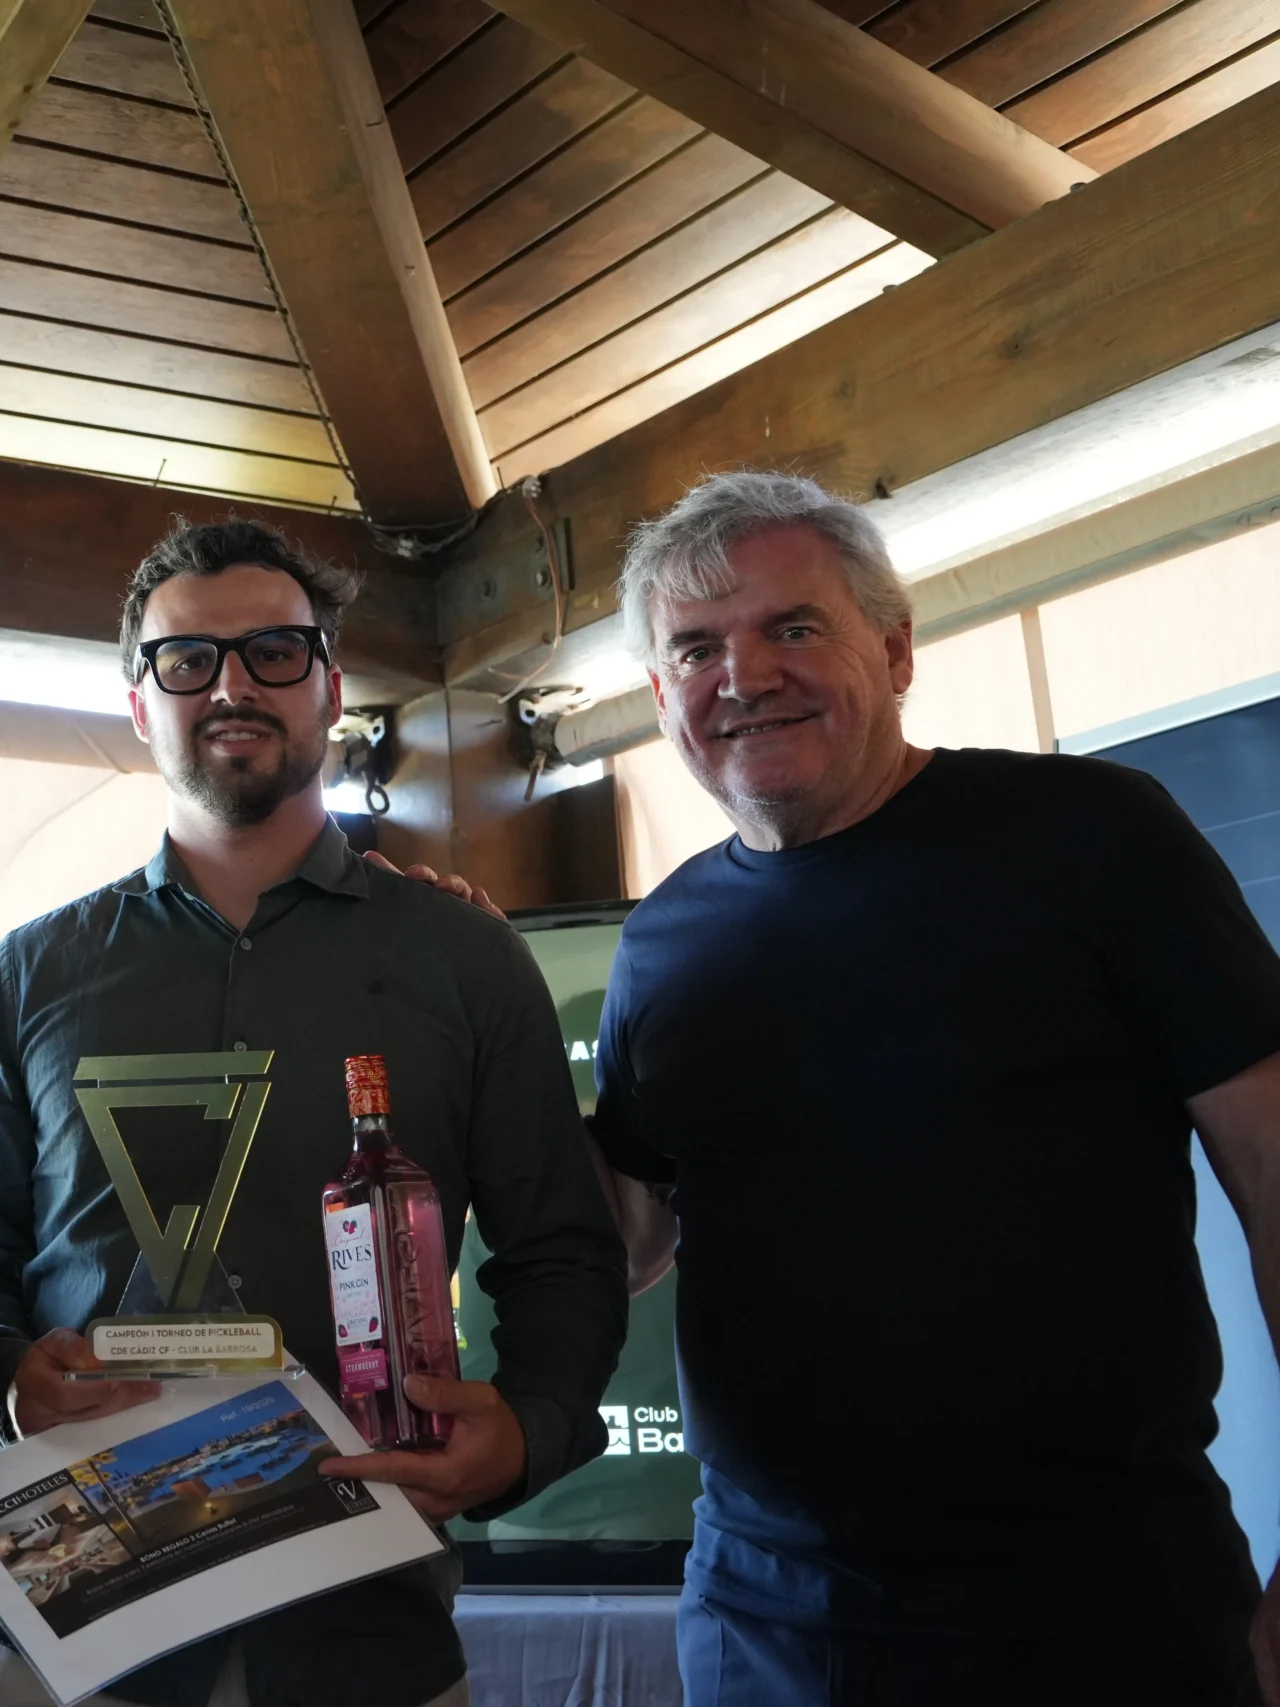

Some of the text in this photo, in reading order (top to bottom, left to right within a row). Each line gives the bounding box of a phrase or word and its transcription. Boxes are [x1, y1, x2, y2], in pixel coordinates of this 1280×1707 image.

[331, 1244, 372, 1270] RIVES
[339, 1278, 369, 1291] PINK GIN
[106, 1329, 148, 1338] CAMPEÓN
[156, 1329, 193, 1337] TORNEO
[195, 1329, 206, 1337] DE
[208, 1328, 262, 1337] PICKLEBALL
[110, 1347, 128, 1355] CDE
[158, 1346, 170, 1355] CF
[202, 1345, 214, 1353] LA
[345, 1360, 379, 1373] STRAWBERRY
[634, 1406, 678, 1423] Club
[140, 1550, 161, 1563] BONO
[162, 1537, 190, 1553] REGALO
